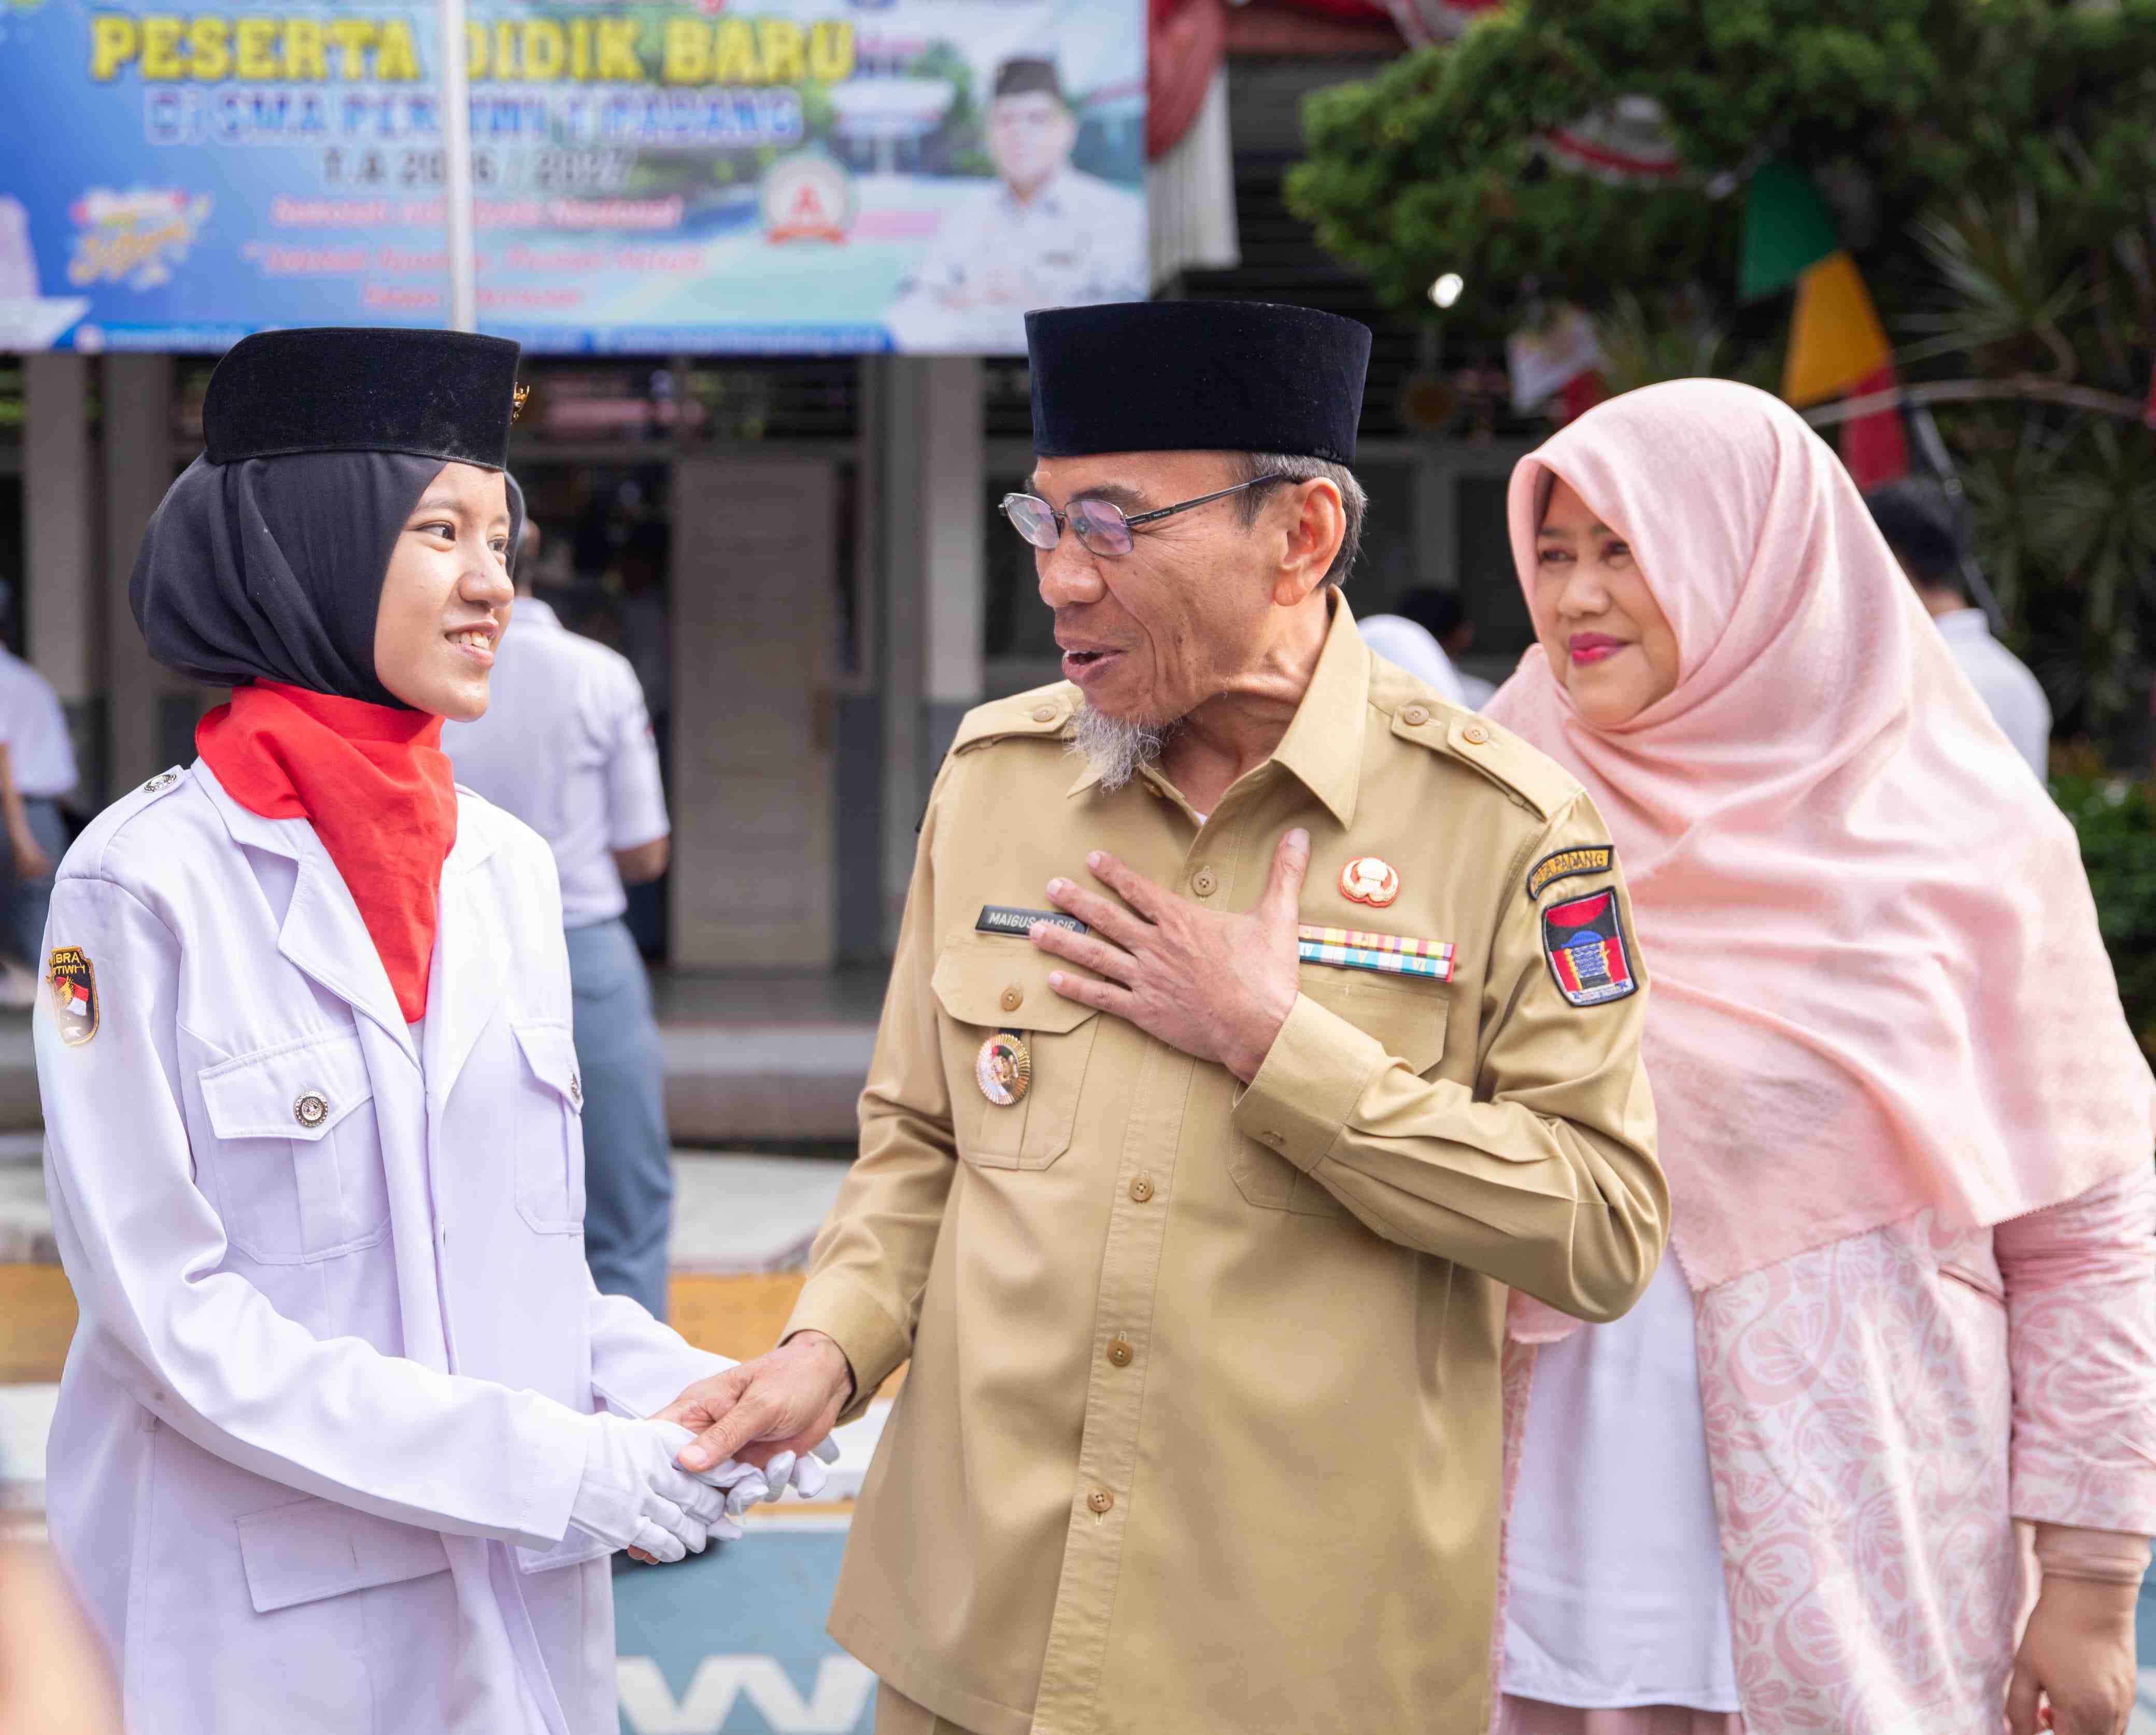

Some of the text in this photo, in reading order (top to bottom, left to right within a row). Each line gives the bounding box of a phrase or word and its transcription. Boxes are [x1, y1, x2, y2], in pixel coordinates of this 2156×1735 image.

[90, 16, 421, 80] PESERTA
[663, 19, 855, 84] BARU
[343, 87, 546, 140] PERIWI
[988, 912, 1036, 929] MAIGUS
